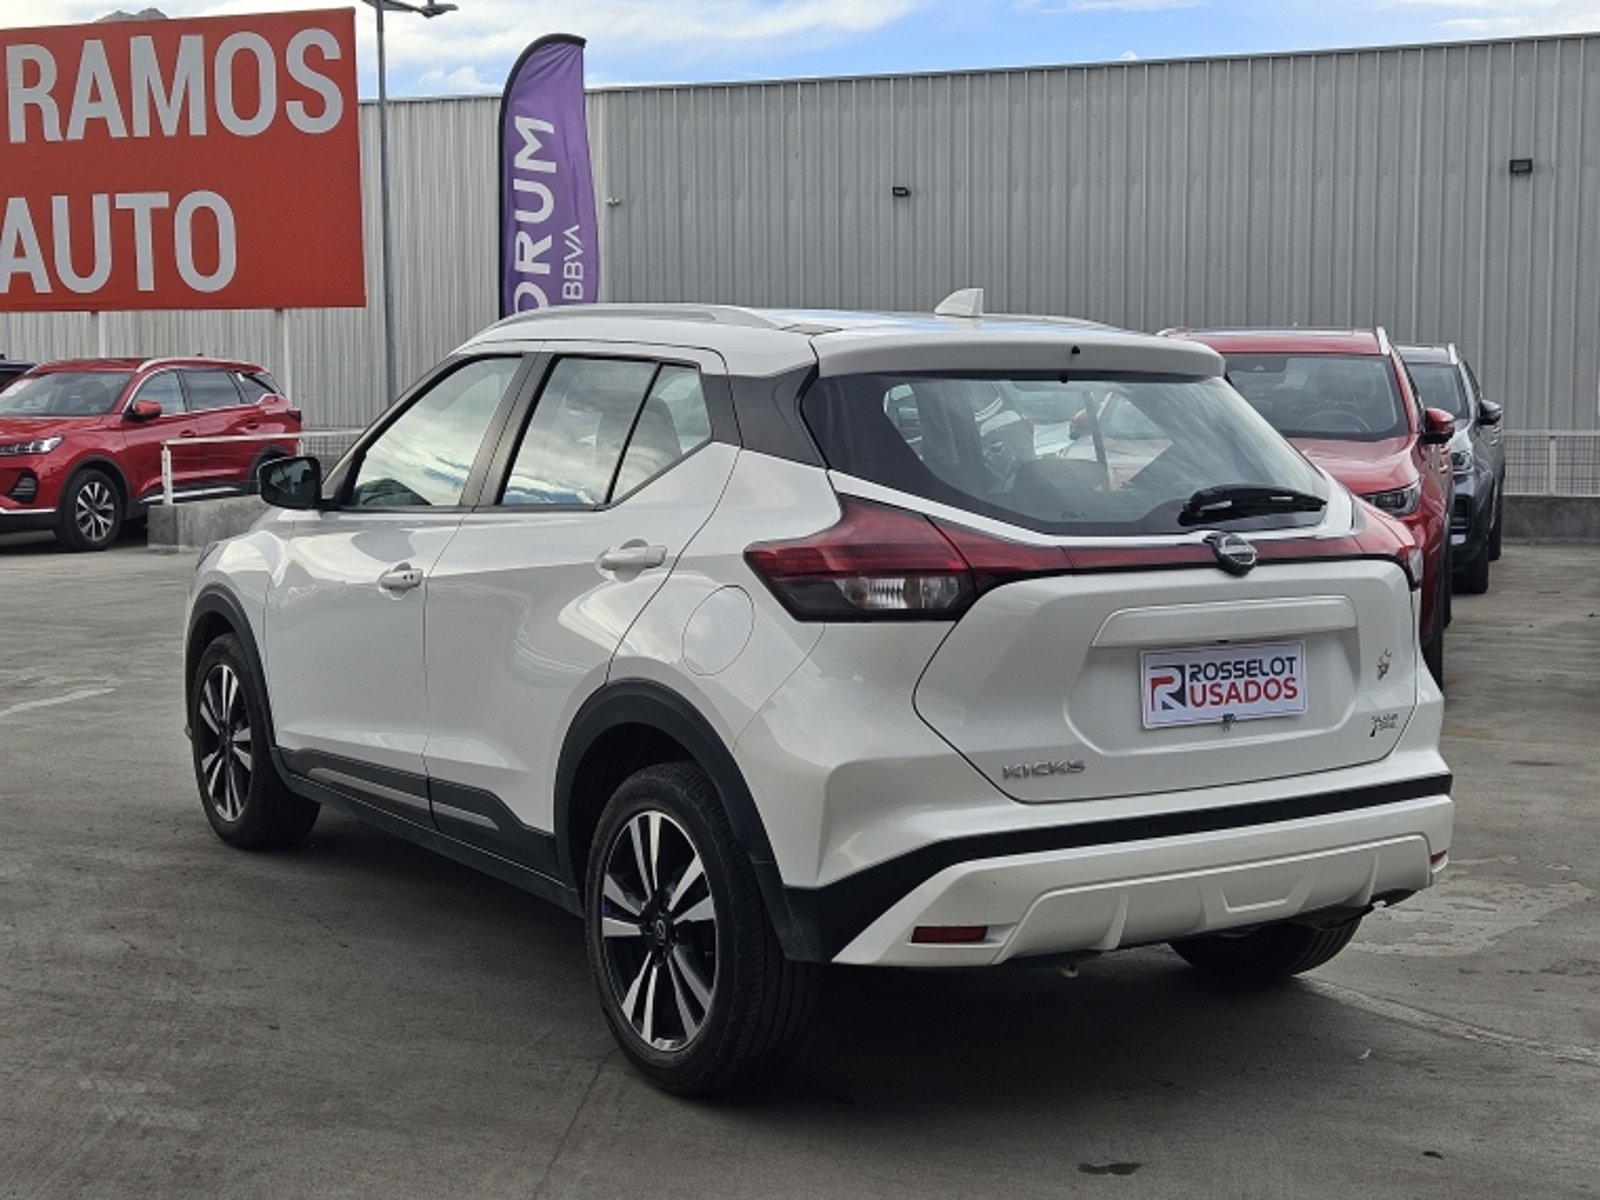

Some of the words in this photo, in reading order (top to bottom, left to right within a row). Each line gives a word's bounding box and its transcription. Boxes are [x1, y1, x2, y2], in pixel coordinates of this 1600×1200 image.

[6, 28, 344, 143] RAMOS
[0, 190, 237, 294] AUTO
[562, 224, 584, 300] BBVA
[1189, 656, 1297, 682] ROSSELOT
[1189, 677, 1298, 708] USADOS
[1002, 759, 1085, 779] KICKS
